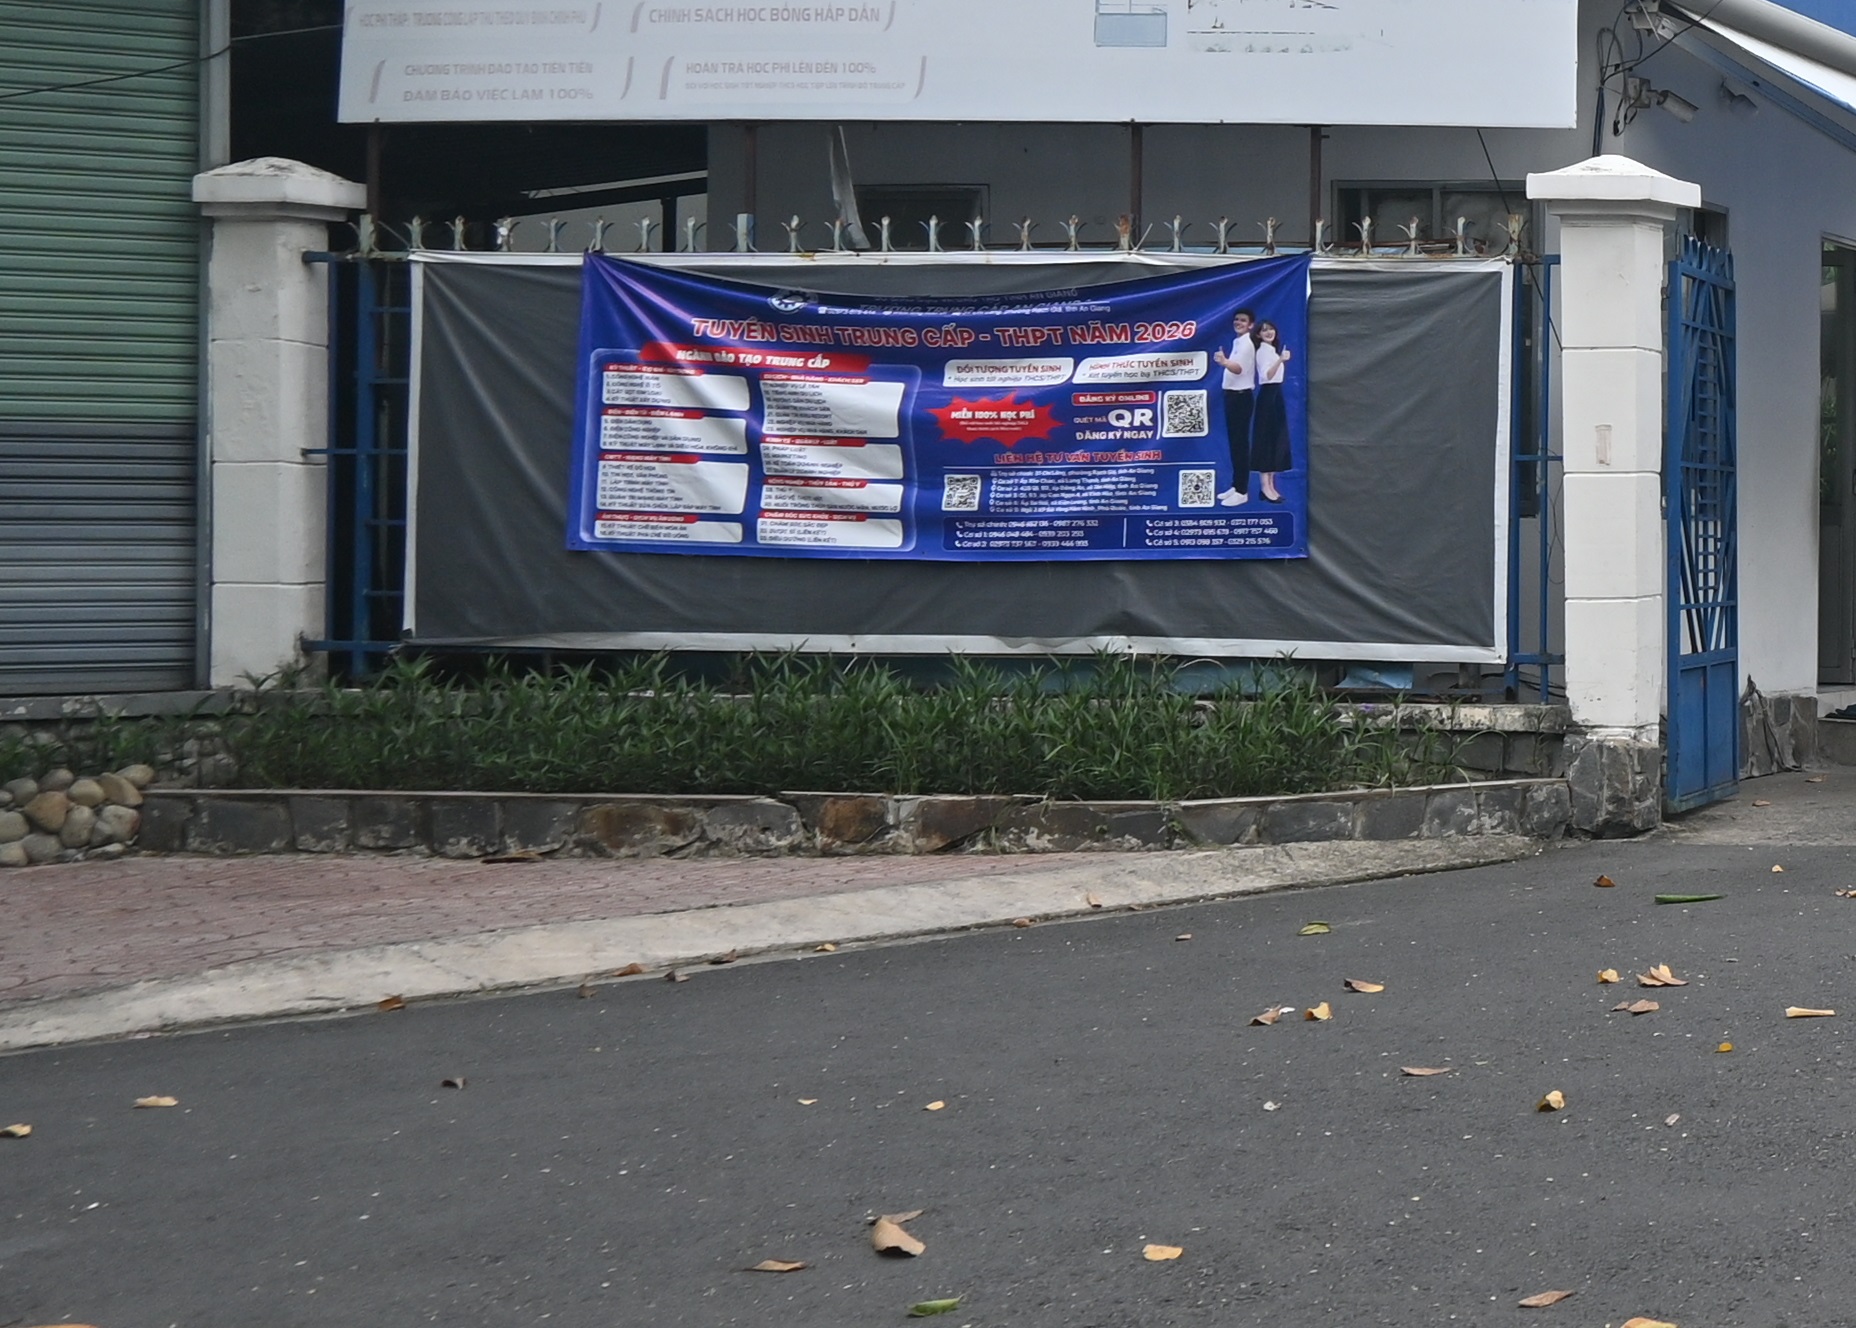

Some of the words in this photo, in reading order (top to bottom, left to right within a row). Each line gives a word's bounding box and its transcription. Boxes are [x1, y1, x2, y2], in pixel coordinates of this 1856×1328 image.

[780, 326, 834, 344] SINH
[836, 327, 917, 347] TRUNG
[922, 323, 974, 347] CẤP
[996, 328, 1062, 347] THPT
[1071, 321, 1130, 344] NĂM
[1135, 321, 1196, 341] 2026
[1108, 409, 1153, 427] QR
[1134, 450, 1161, 460] SINH
